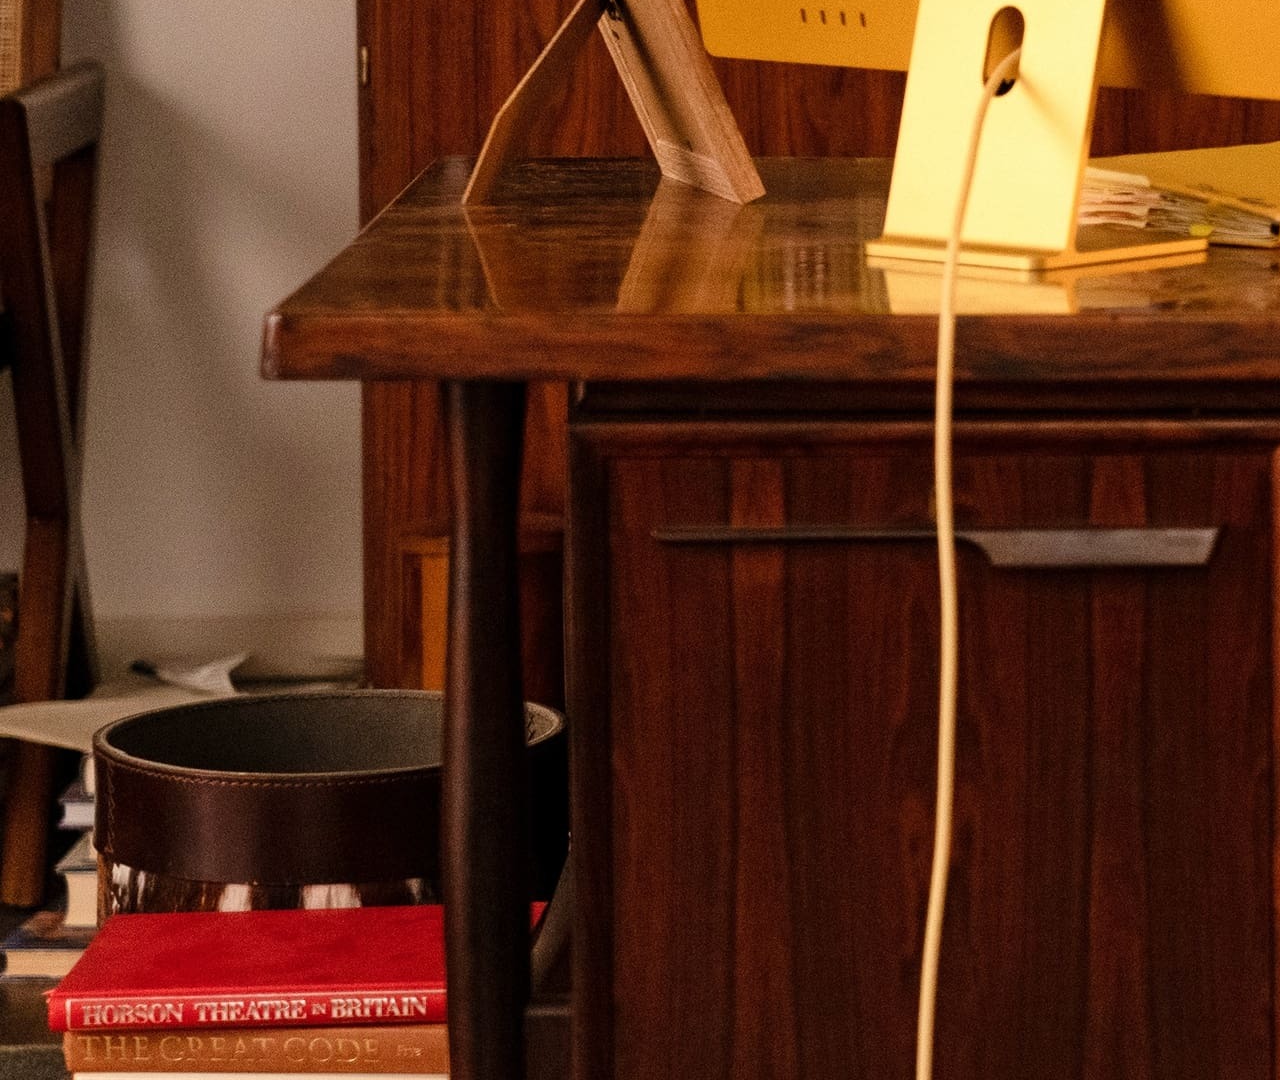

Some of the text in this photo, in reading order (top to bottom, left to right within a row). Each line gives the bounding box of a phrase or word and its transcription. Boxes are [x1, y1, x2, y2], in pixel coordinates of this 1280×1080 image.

[81, 996, 428, 1026] HOBSON THEATRE IN BRITAIN
[77, 1035, 151, 1062] THE
[159, 1036, 275, 1062] GREAT
[283, 1036, 381, 1063] CODE
